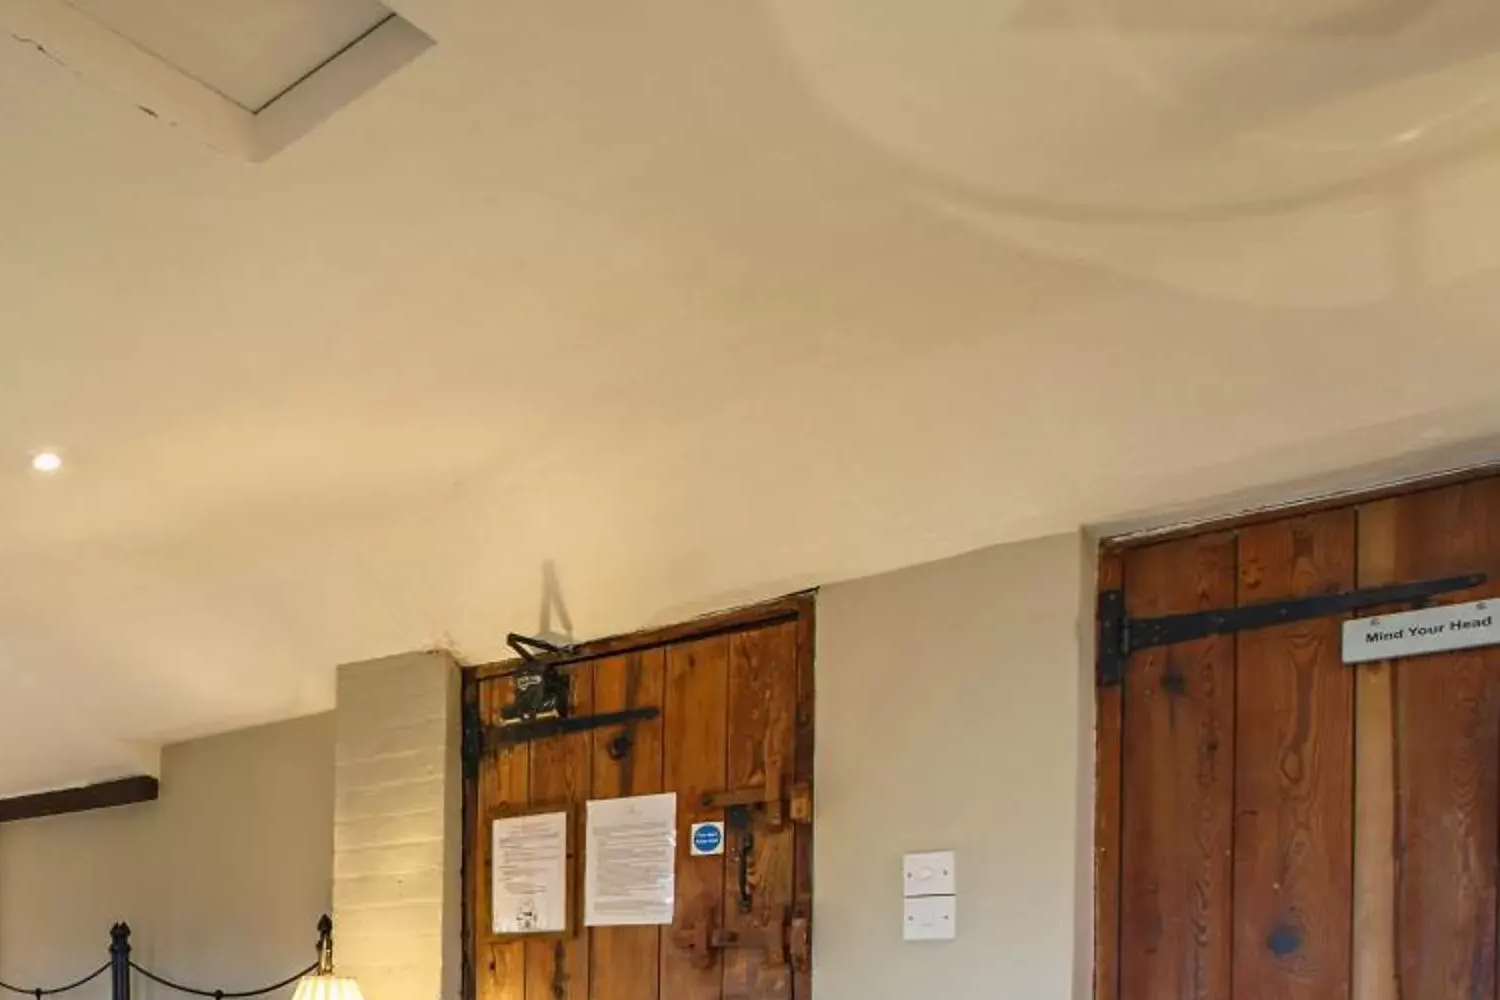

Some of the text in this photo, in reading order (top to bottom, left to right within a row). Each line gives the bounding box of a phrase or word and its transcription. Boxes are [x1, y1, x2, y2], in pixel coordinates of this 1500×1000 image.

[1365, 616, 1493, 643] Mind Your Head
